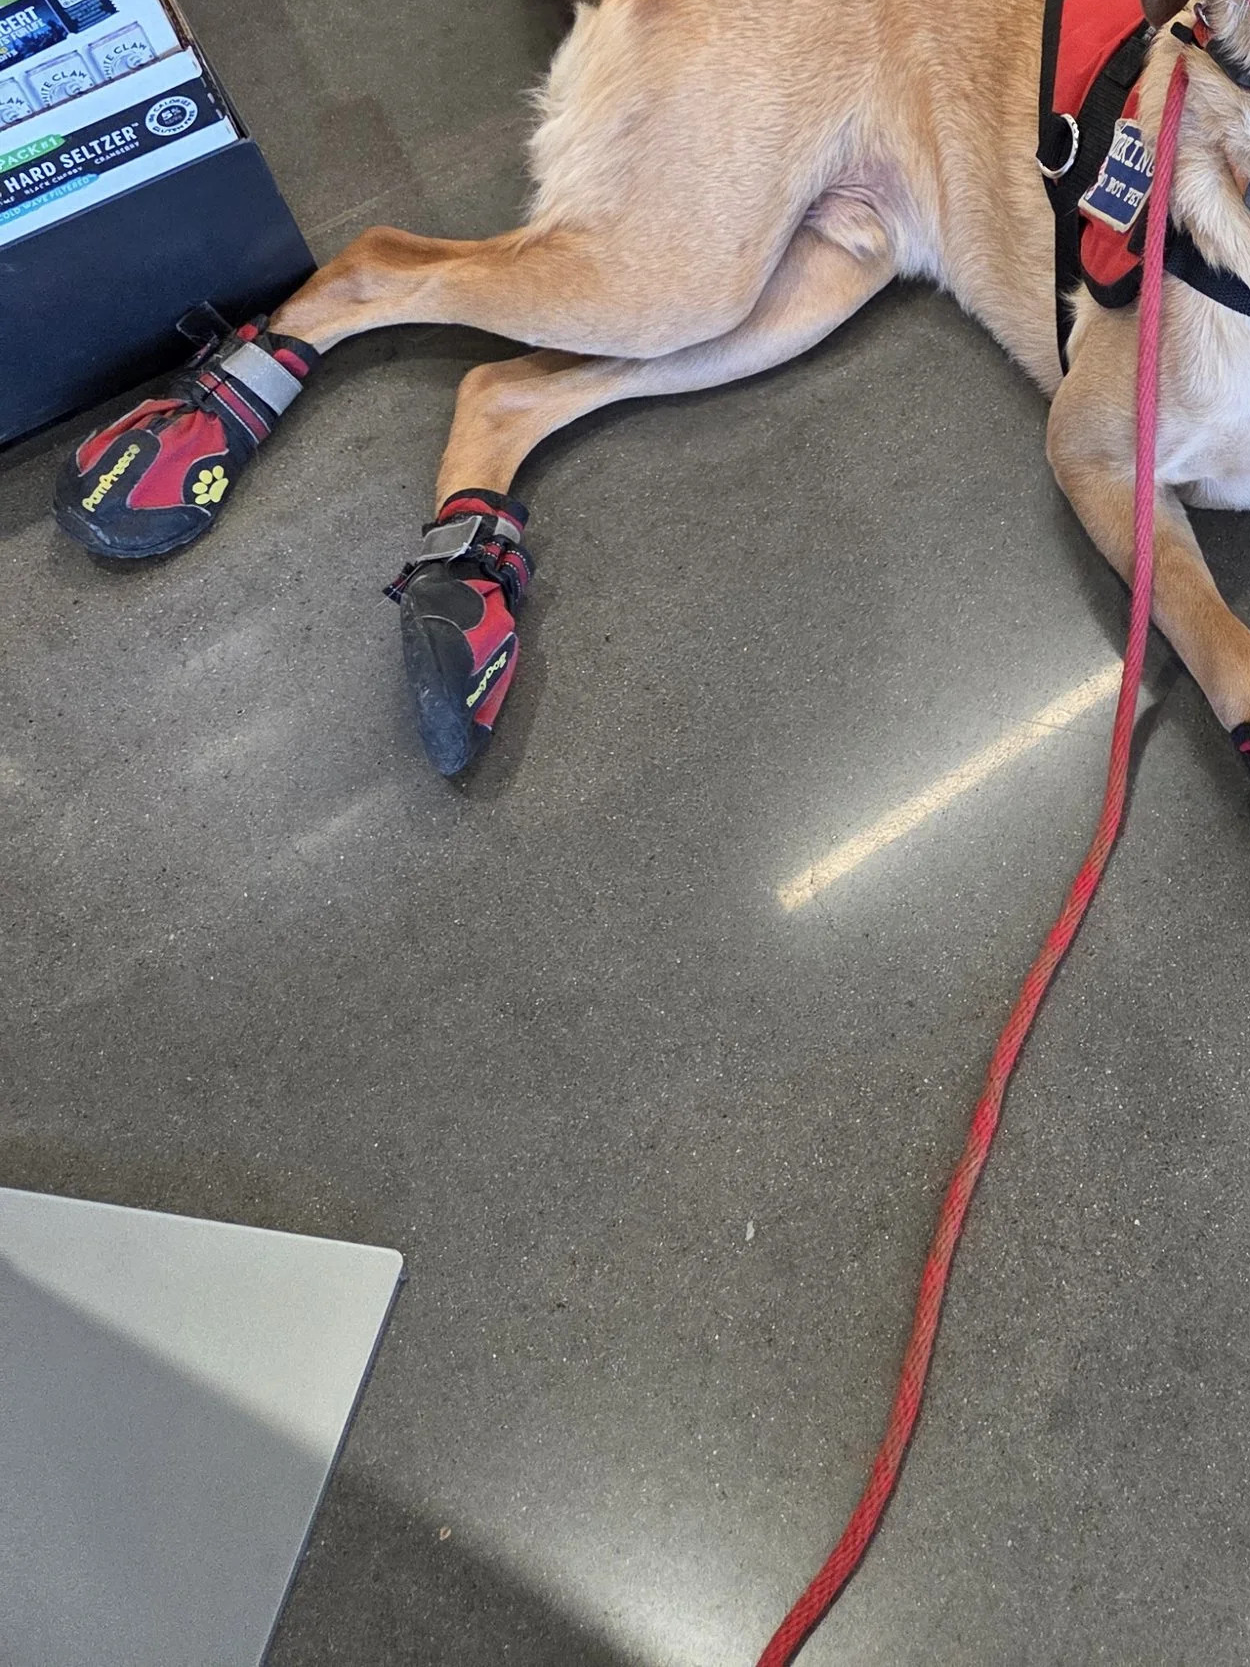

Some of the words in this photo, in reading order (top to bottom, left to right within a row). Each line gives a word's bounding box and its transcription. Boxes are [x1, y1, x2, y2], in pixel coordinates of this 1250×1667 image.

[0, 5, 38, 35] CERT
[4, 161, 56, 193] HARD
[1123, 186, 1145, 208] PET
